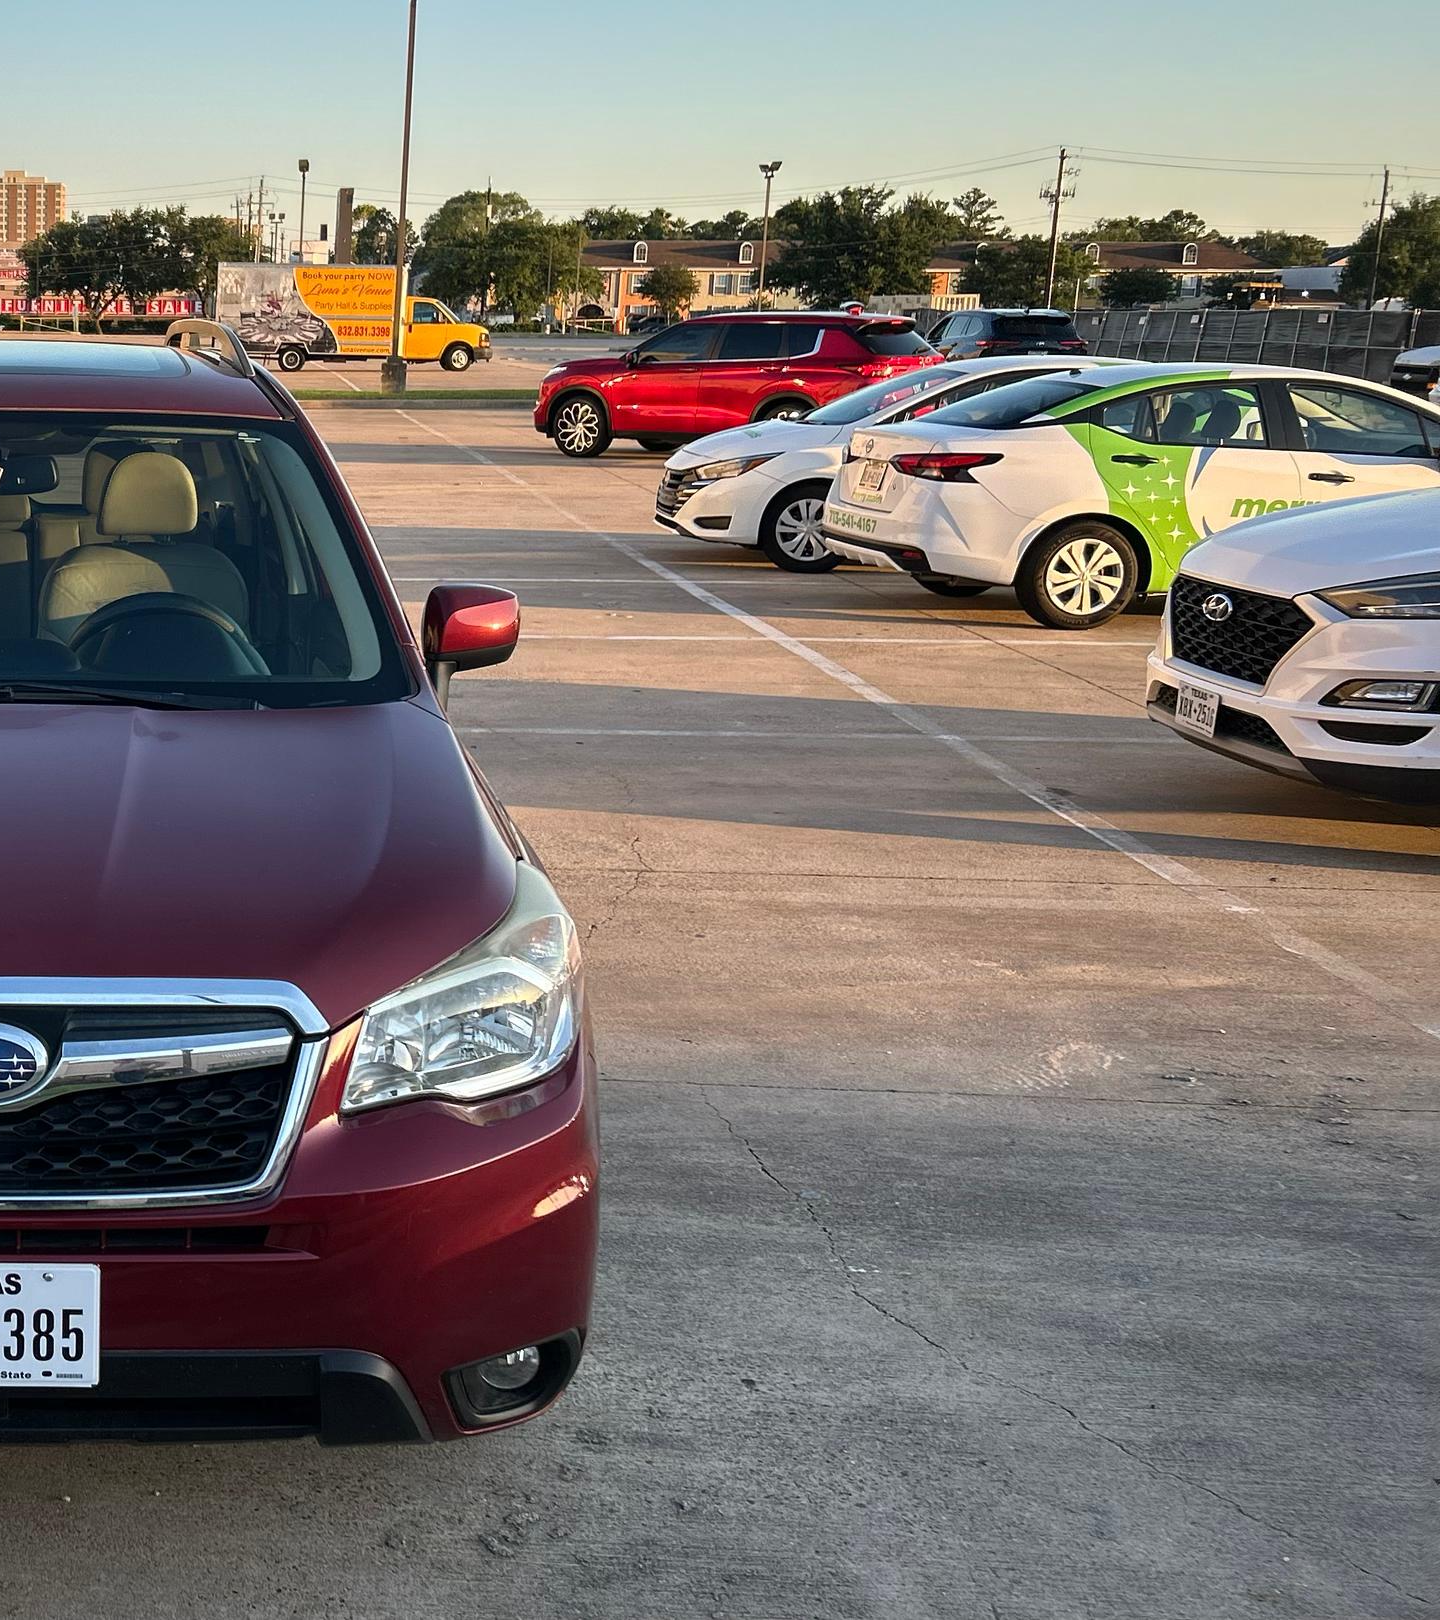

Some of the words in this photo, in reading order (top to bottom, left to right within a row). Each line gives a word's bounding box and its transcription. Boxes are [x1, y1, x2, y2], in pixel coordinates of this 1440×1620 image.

[302, 272, 322, 280] Book
[324, 273, 342, 281] your
[344, 273, 366, 281] party
[367, 272, 395, 280] NOW!
[304, 283, 349, 297] Luna's
[352, 284, 393, 297] Venue
[150, 300, 203, 314] SALE
[315, 301, 334, 311] Party
[336, 301, 351, 310] Hall
[352, 302, 358, 310] &
[359, 302, 393, 311] Supplies
[829, 510, 877, 533] 713-541-4167
[0, 1370, 32, 1379] State
